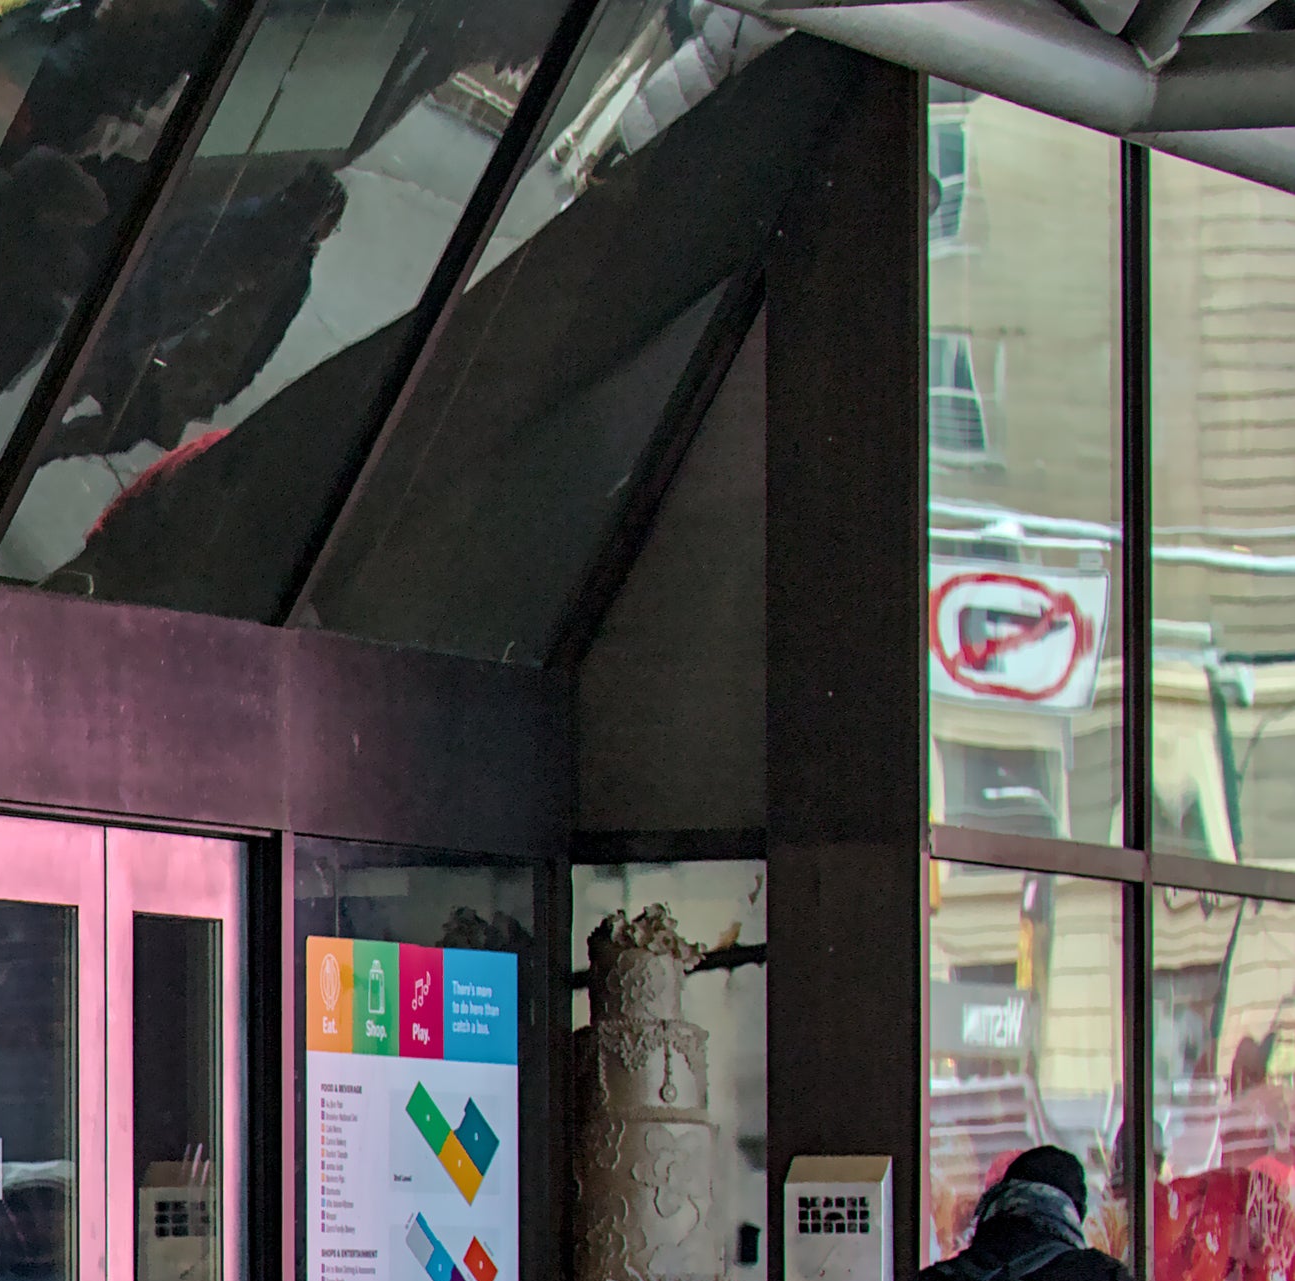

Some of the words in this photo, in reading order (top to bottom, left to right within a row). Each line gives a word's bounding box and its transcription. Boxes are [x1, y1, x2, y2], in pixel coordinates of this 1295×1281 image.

[452, 980, 475, 997] There's
[476, 985, 493, 999] more
[452, 1001, 460, 1014] to
[461, 1002, 469, 1015] do
[470, 1003, 484, 1016] here
[484, 1003, 500, 1017] than
[322, 1016, 338, 1034] Eat.
[365, 1020, 387, 1043] Shop.
[412, 1022, 430, 1045] Play.
[452, 1020, 470, 1034] catch
[471, 1023, 476, 1034] a
[476, 1021, 490, 1035] bus.
[321, 1083, 334, 1093] FOOD
[338, 1084, 362, 1095] BEVERAGE
[321, 1249, 336, 1258] SHOPS
[341, 1249, 378, 1259] ENTERTAINMENT
